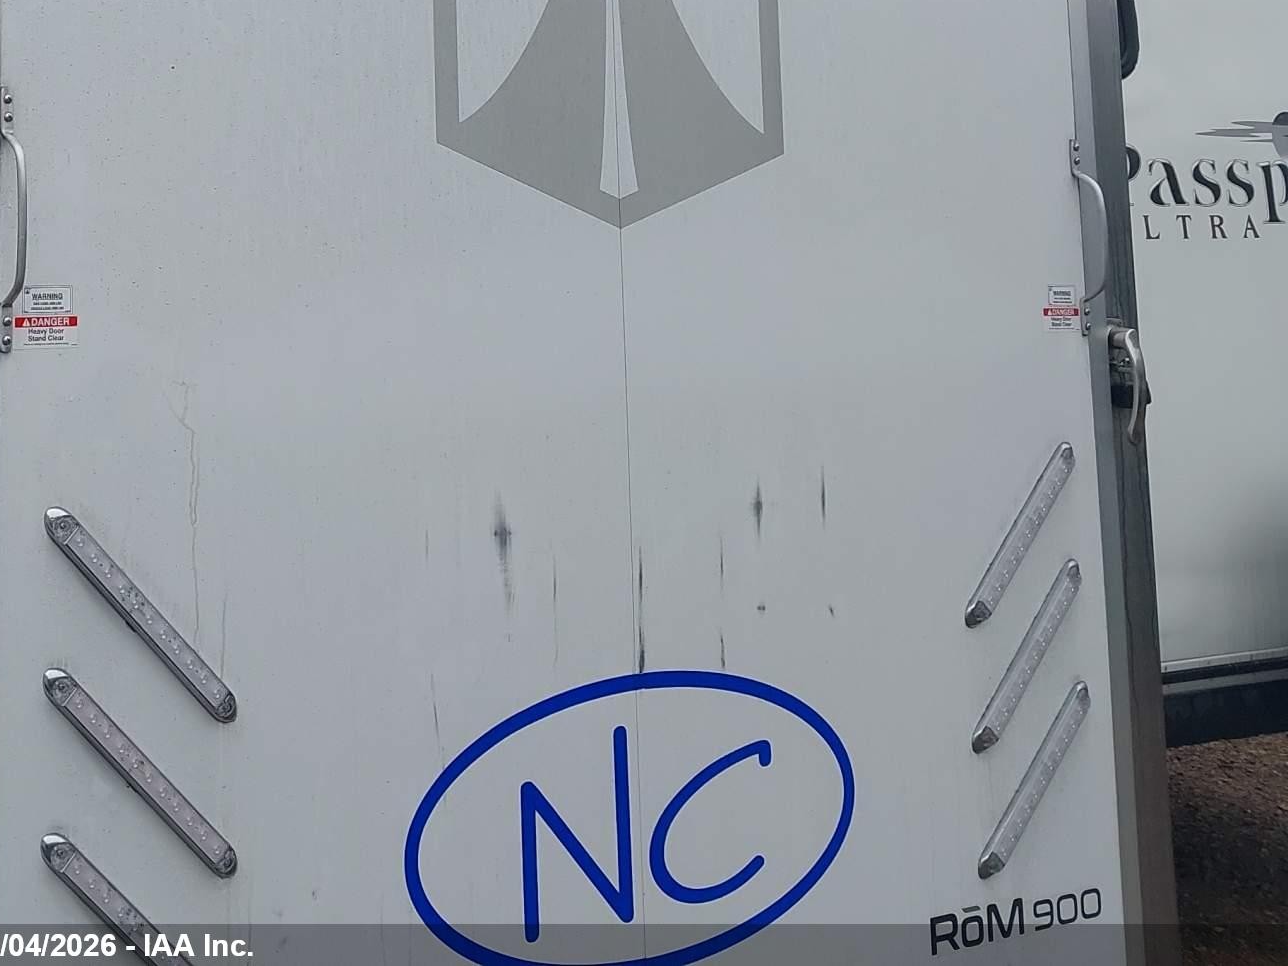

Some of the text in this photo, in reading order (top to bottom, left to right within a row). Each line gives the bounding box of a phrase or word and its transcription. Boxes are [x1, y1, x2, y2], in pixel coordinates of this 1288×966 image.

[31, 292, 63, 301] WARNING
[31, 317, 70, 327] DANGER
[28, 327, 64, 337] Heavy Door
[520, 725, 773, 944] NC
[1033, 887, 1102, 932] 900
